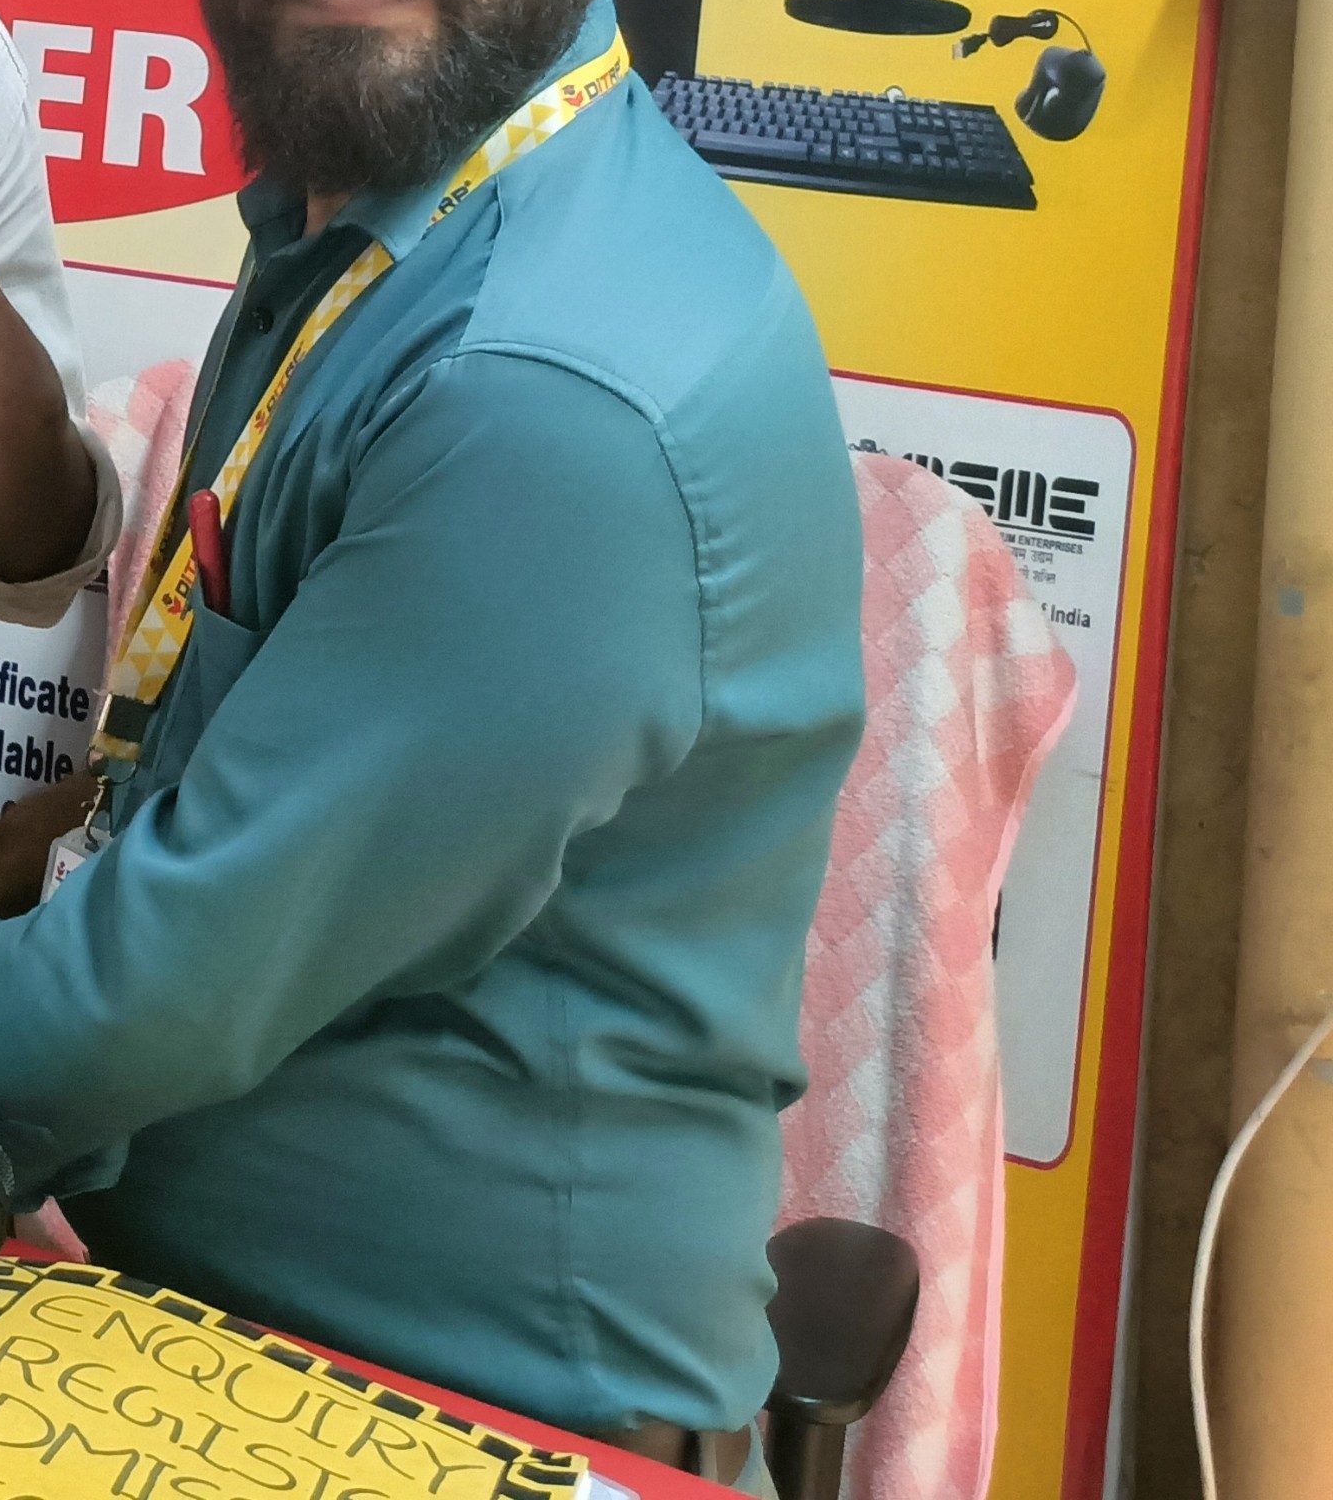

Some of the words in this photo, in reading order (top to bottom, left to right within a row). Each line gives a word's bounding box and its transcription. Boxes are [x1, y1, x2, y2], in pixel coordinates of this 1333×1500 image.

[12, 20, 209, 175] ER
[1018, 535, 1083, 554] ENTERPRISES
[1050, 604, 1091, 628] India
[30, 1294, 487, 1495] ENQUIRY
